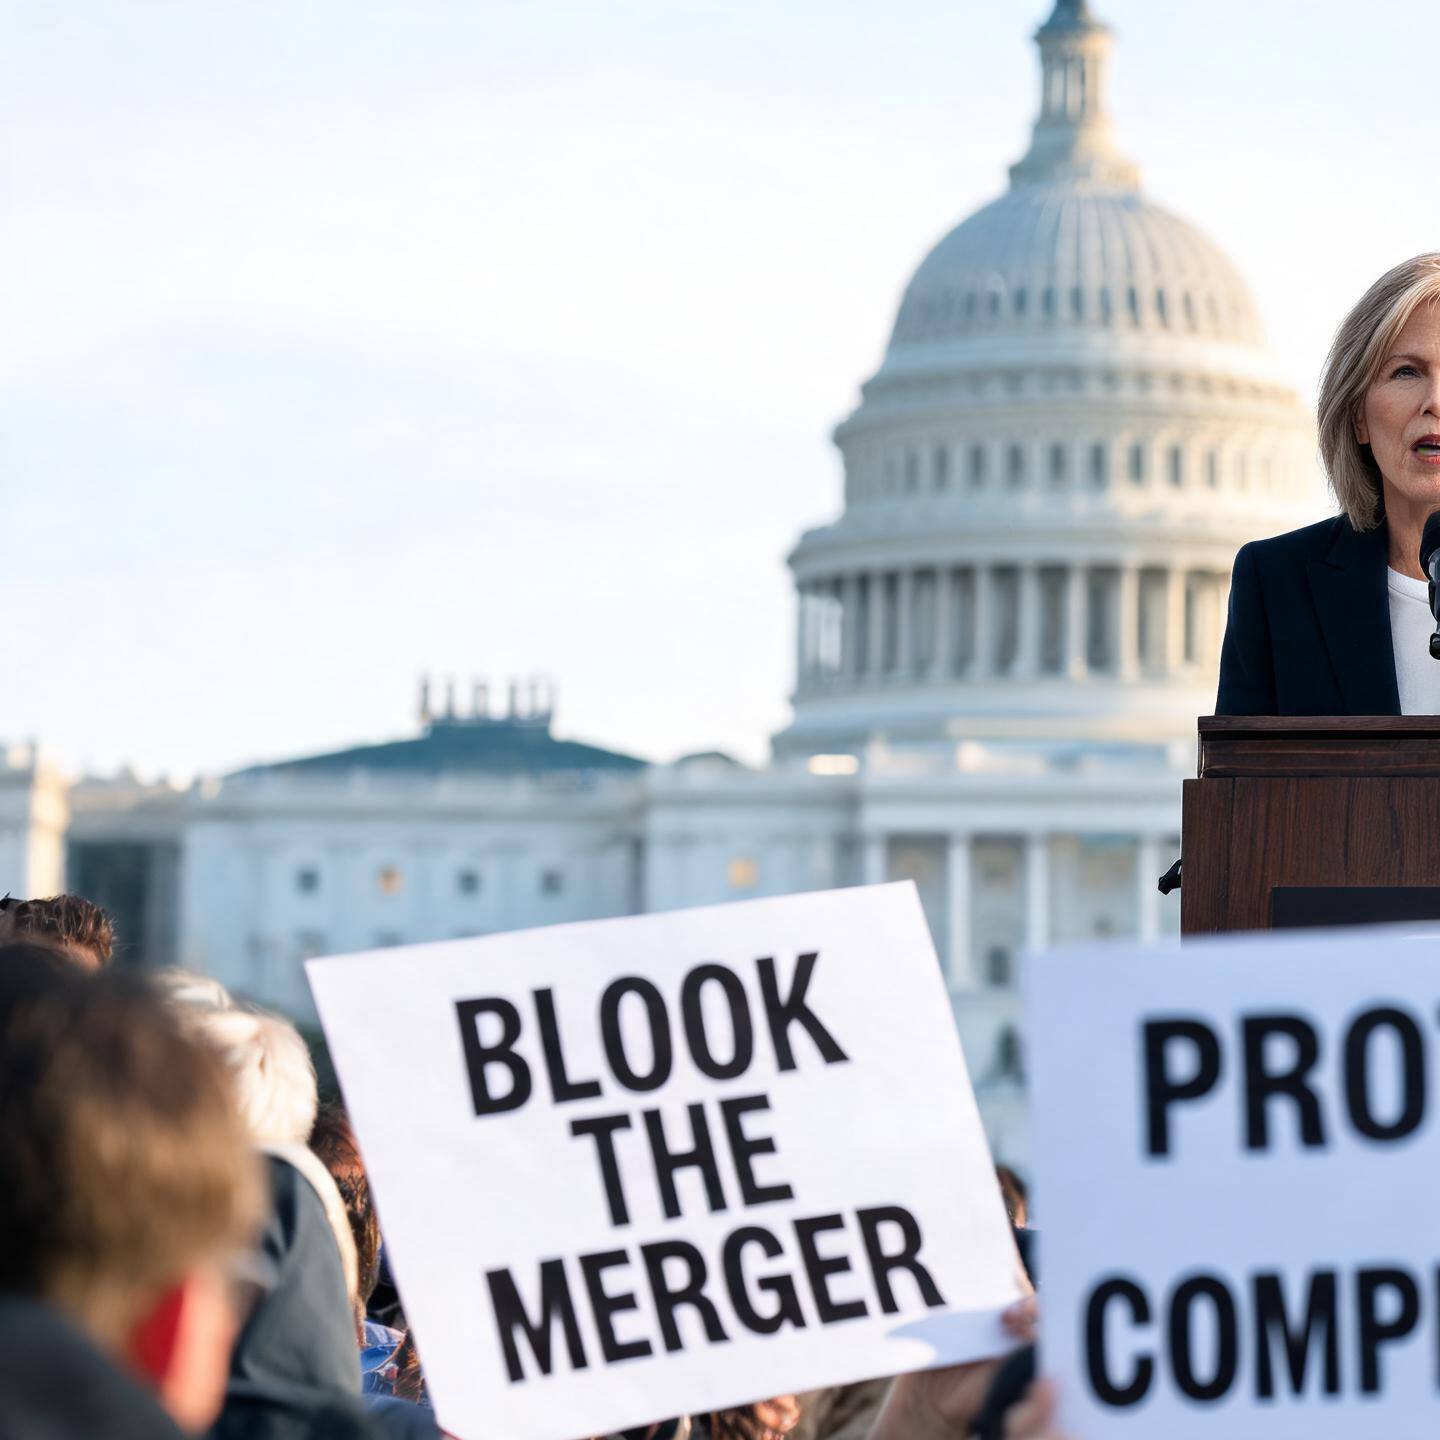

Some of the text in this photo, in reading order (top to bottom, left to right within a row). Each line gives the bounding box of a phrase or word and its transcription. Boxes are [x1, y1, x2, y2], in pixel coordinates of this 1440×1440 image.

[454, 951, 850, 1117] BLOOK
[569, 1093, 795, 1228] THE
[484, 1205, 948, 1384] MERGER
